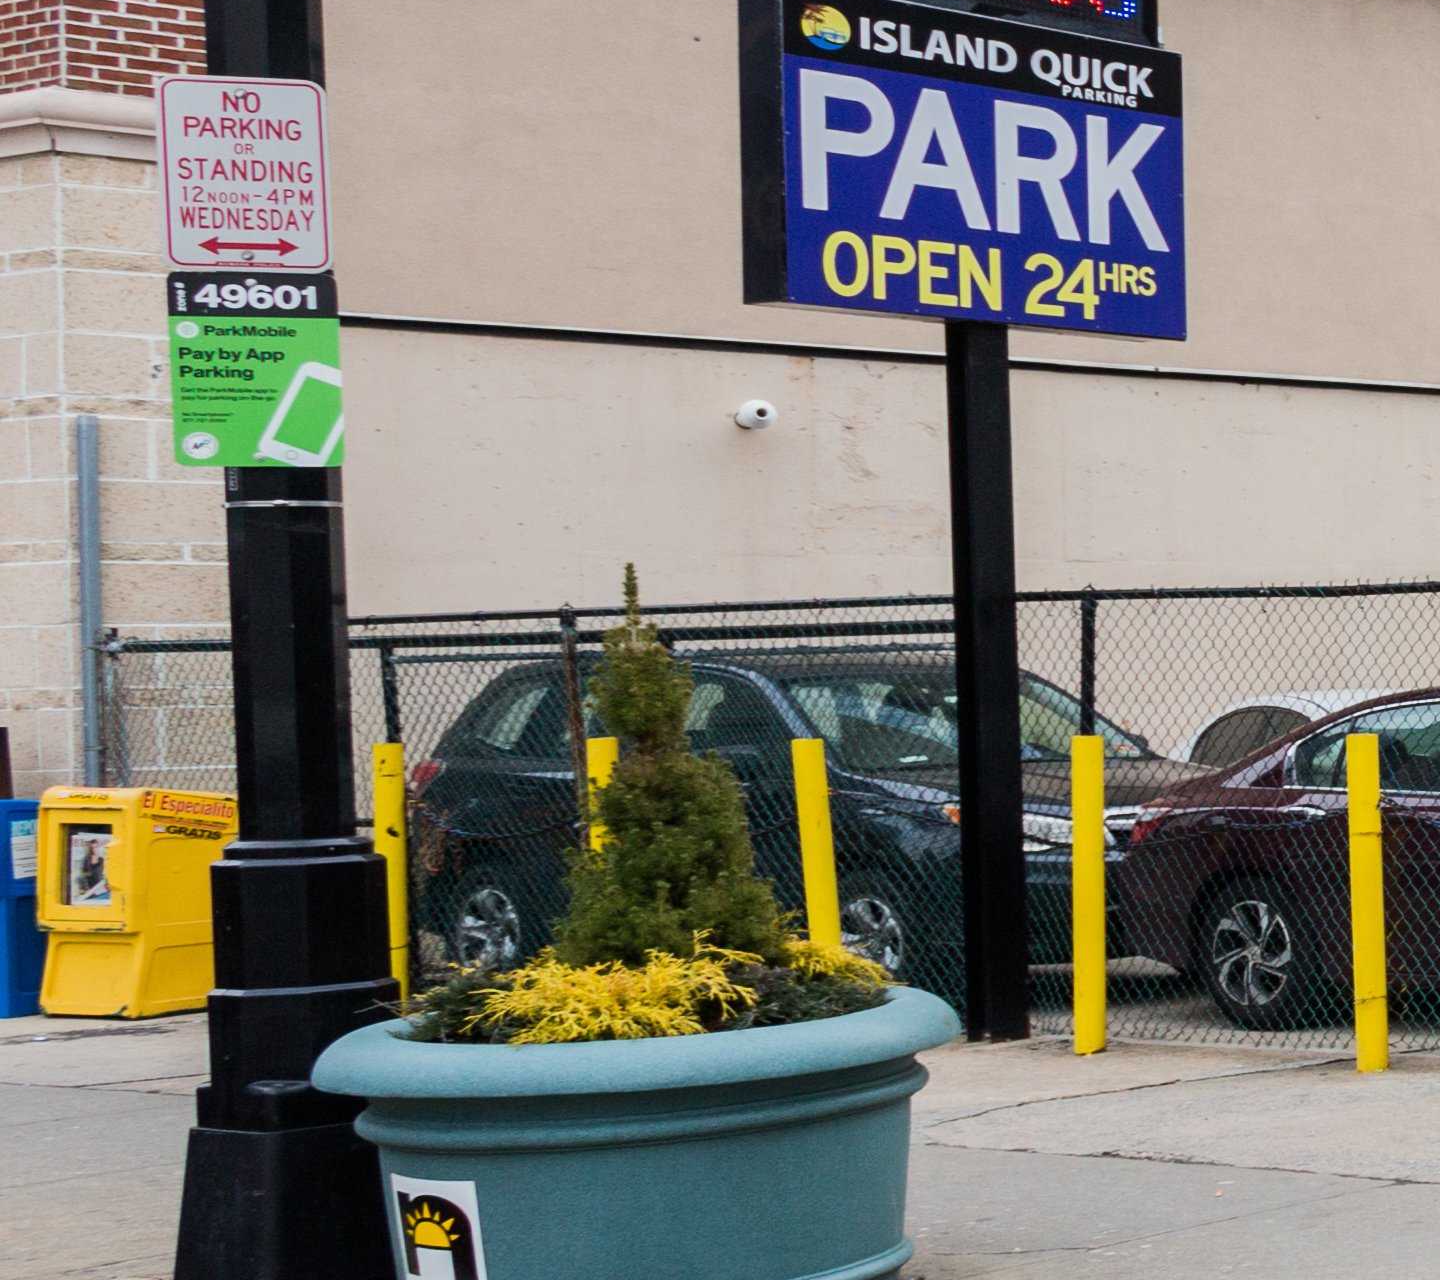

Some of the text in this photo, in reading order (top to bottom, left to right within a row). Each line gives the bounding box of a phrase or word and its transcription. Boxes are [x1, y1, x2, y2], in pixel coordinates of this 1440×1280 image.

[859, 16, 1154, 98] ISLAND QUICK
[222, 91, 260, 113] NO
[1062, 85, 1138, 108] PARKING
[183, 116, 302, 141] PARKING
[234, 144, 254, 155] OR
[800, 68, 1170, 252] PARK
[178, 158, 312, 183] STANDING
[180, 207, 314, 231] WEDNESDAY
[822, 231, 1001, 312] OPEN
[194, 284, 317, 309] 49601
[204, 325, 297, 338] ParkMobile
[179, 347, 285, 363] Pay by App
[179, 366, 254, 380] Parking
[142, 790, 234, 818] El Especialito
[166, 824, 222, 841] GRATIS
